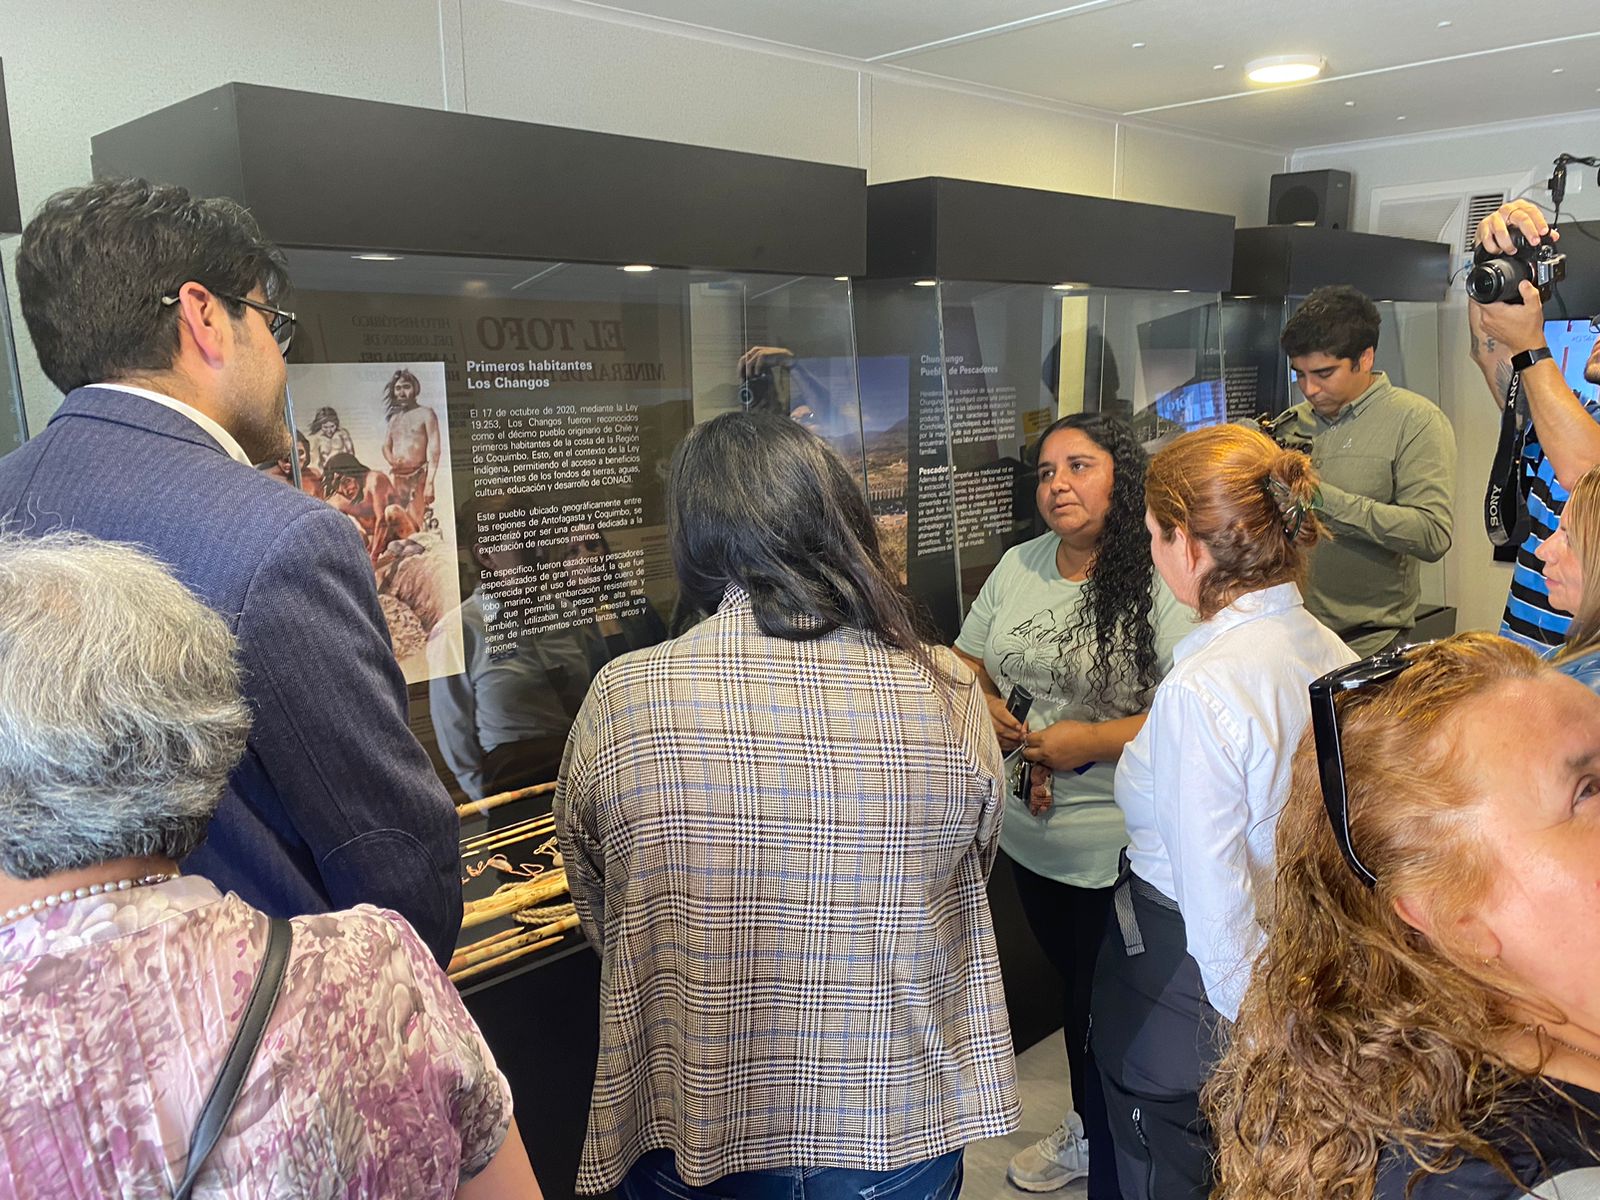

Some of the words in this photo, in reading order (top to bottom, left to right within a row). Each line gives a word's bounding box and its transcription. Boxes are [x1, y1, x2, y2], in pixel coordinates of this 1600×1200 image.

[466, 361, 525, 372] Primeros
[528, 359, 592, 371] habitantes
[920, 355, 964, 365] Chunungo
[920, 367, 945, 377] Puebl
[949, 367, 957, 375] de
[959, 366, 998, 375] Pescadores
[467, 378, 490, 389] Los
[494, 377, 549, 391] Changos
[469, 408, 478, 417] El
[482, 408, 492, 417] 17
[495, 407, 506, 416] de
[509, 406, 539, 416] octubre
[542, 406, 552, 415] de
[580, 404, 613, 413] mediante
[616, 403, 622, 412] la
[625, 403, 638, 414] Ley
[507, 418, 522, 427] Los
[528, 417, 562, 428] Changos
[567, 416, 591, 425] fueron
[471, 433, 494, 441] como
[497, 430, 505, 439] el
[507, 429, 537, 439] décimo
[539, 427, 565, 439] pueblo
[567, 425, 601, 437] originario
[602, 425, 612, 434] de
[471, 442, 508, 454] primeros
[510, 440, 551, 450] habitantes
[552, 438, 563, 447] de
[564, 437, 571, 446] la
[573, 437, 593, 446] costa
[595, 435, 605, 445] de
[606, 435, 613, 444] la
[472, 454, 483, 463] de
[531, 451, 551, 460] Esto,
[565, 448, 572, 457] el
[574, 447, 606, 457] contexto
[607, 446, 617, 455] de
[618, 445, 625, 454] la
[627, 444, 639, 455] Ley
[513, 460, 559, 474] permitiendo
[561, 459, 568, 468] el
[570, 459, 596, 467] acceso
[918, 465, 957, 475] Pescadors
[474, 475, 526, 488] provenientes
[528, 473, 538, 482] de
[540, 472, 551, 481] los
[553, 470, 579, 480] fondos
[580, 469, 590, 478] de
[474, 487, 504, 497] cultura,
[506, 482, 545, 494] educación
[553, 478, 589, 490] desarrollo
[590, 478, 600, 487] de
[476, 512, 495, 521] Este
[498, 508, 525, 521] pueblo
[529, 505, 558, 516] ubicado
[561, 498, 621, 515] geográficamente
[623, 496, 641, 506] entre
[1489, 484, 1502, 527] SONY
[477, 523, 489, 532] las
[491, 520, 526, 532] regiones
[528, 517, 538, 526] de
[540, 512, 585, 525] Antofagasta
[633, 507, 642, 515] se
[477, 529, 521, 543] caracterizó
[523, 529, 536, 540] por
[539, 527, 551, 536] ser
[554, 525, 568, 534] una
[570, 522, 594, 532] cultura
[596, 517, 627, 529] dedicada
[636, 515, 642, 524] la
[478, 540, 523, 555] explotación
[525, 539, 535, 548] de
[537, 536, 569, 547] recursos
[480, 570, 491, 579] En
[536, 561, 561, 571] fueron
[605, 549, 644, 563] pescadores
[480, 574, 537, 590] especializados
[539, 572, 549, 581] de
[552, 570, 568, 581] gran
[571, 563, 606, 576] movilidad,
[608, 562, 615, 571] la
[617, 561, 630, 572] que
[632, 559, 644, 568] fue
[524, 585, 537, 596] por
[540, 582, 547, 591] el
[550, 581, 564, 590] uso
[566, 578, 576, 587] de
[578, 575, 601, 586] balsas
[602, 573, 612, 582] de
[614, 571, 633, 580] cuero
[635, 568, 644, 577] de
[537, 594, 551, 602] una
[603, 580, 637, 592] resistente
[503, 609, 518, 621] que
[560, 600, 567, 609] la
[572, 597, 593, 609] pesca
[598, 593, 608, 602] de
[613, 590, 625, 600] alta
[524, 612, 558, 625] utilizaban
[562, 609, 576, 618] con
[580, 606, 596, 617] gran
[633, 597, 645, 606] una
[484, 632, 504, 643] serie
[507, 630, 517, 639] de
[520, 621, 570, 637] instrumentos
[572, 617, 593, 627] como
[621, 608, 639, 618] arcos
